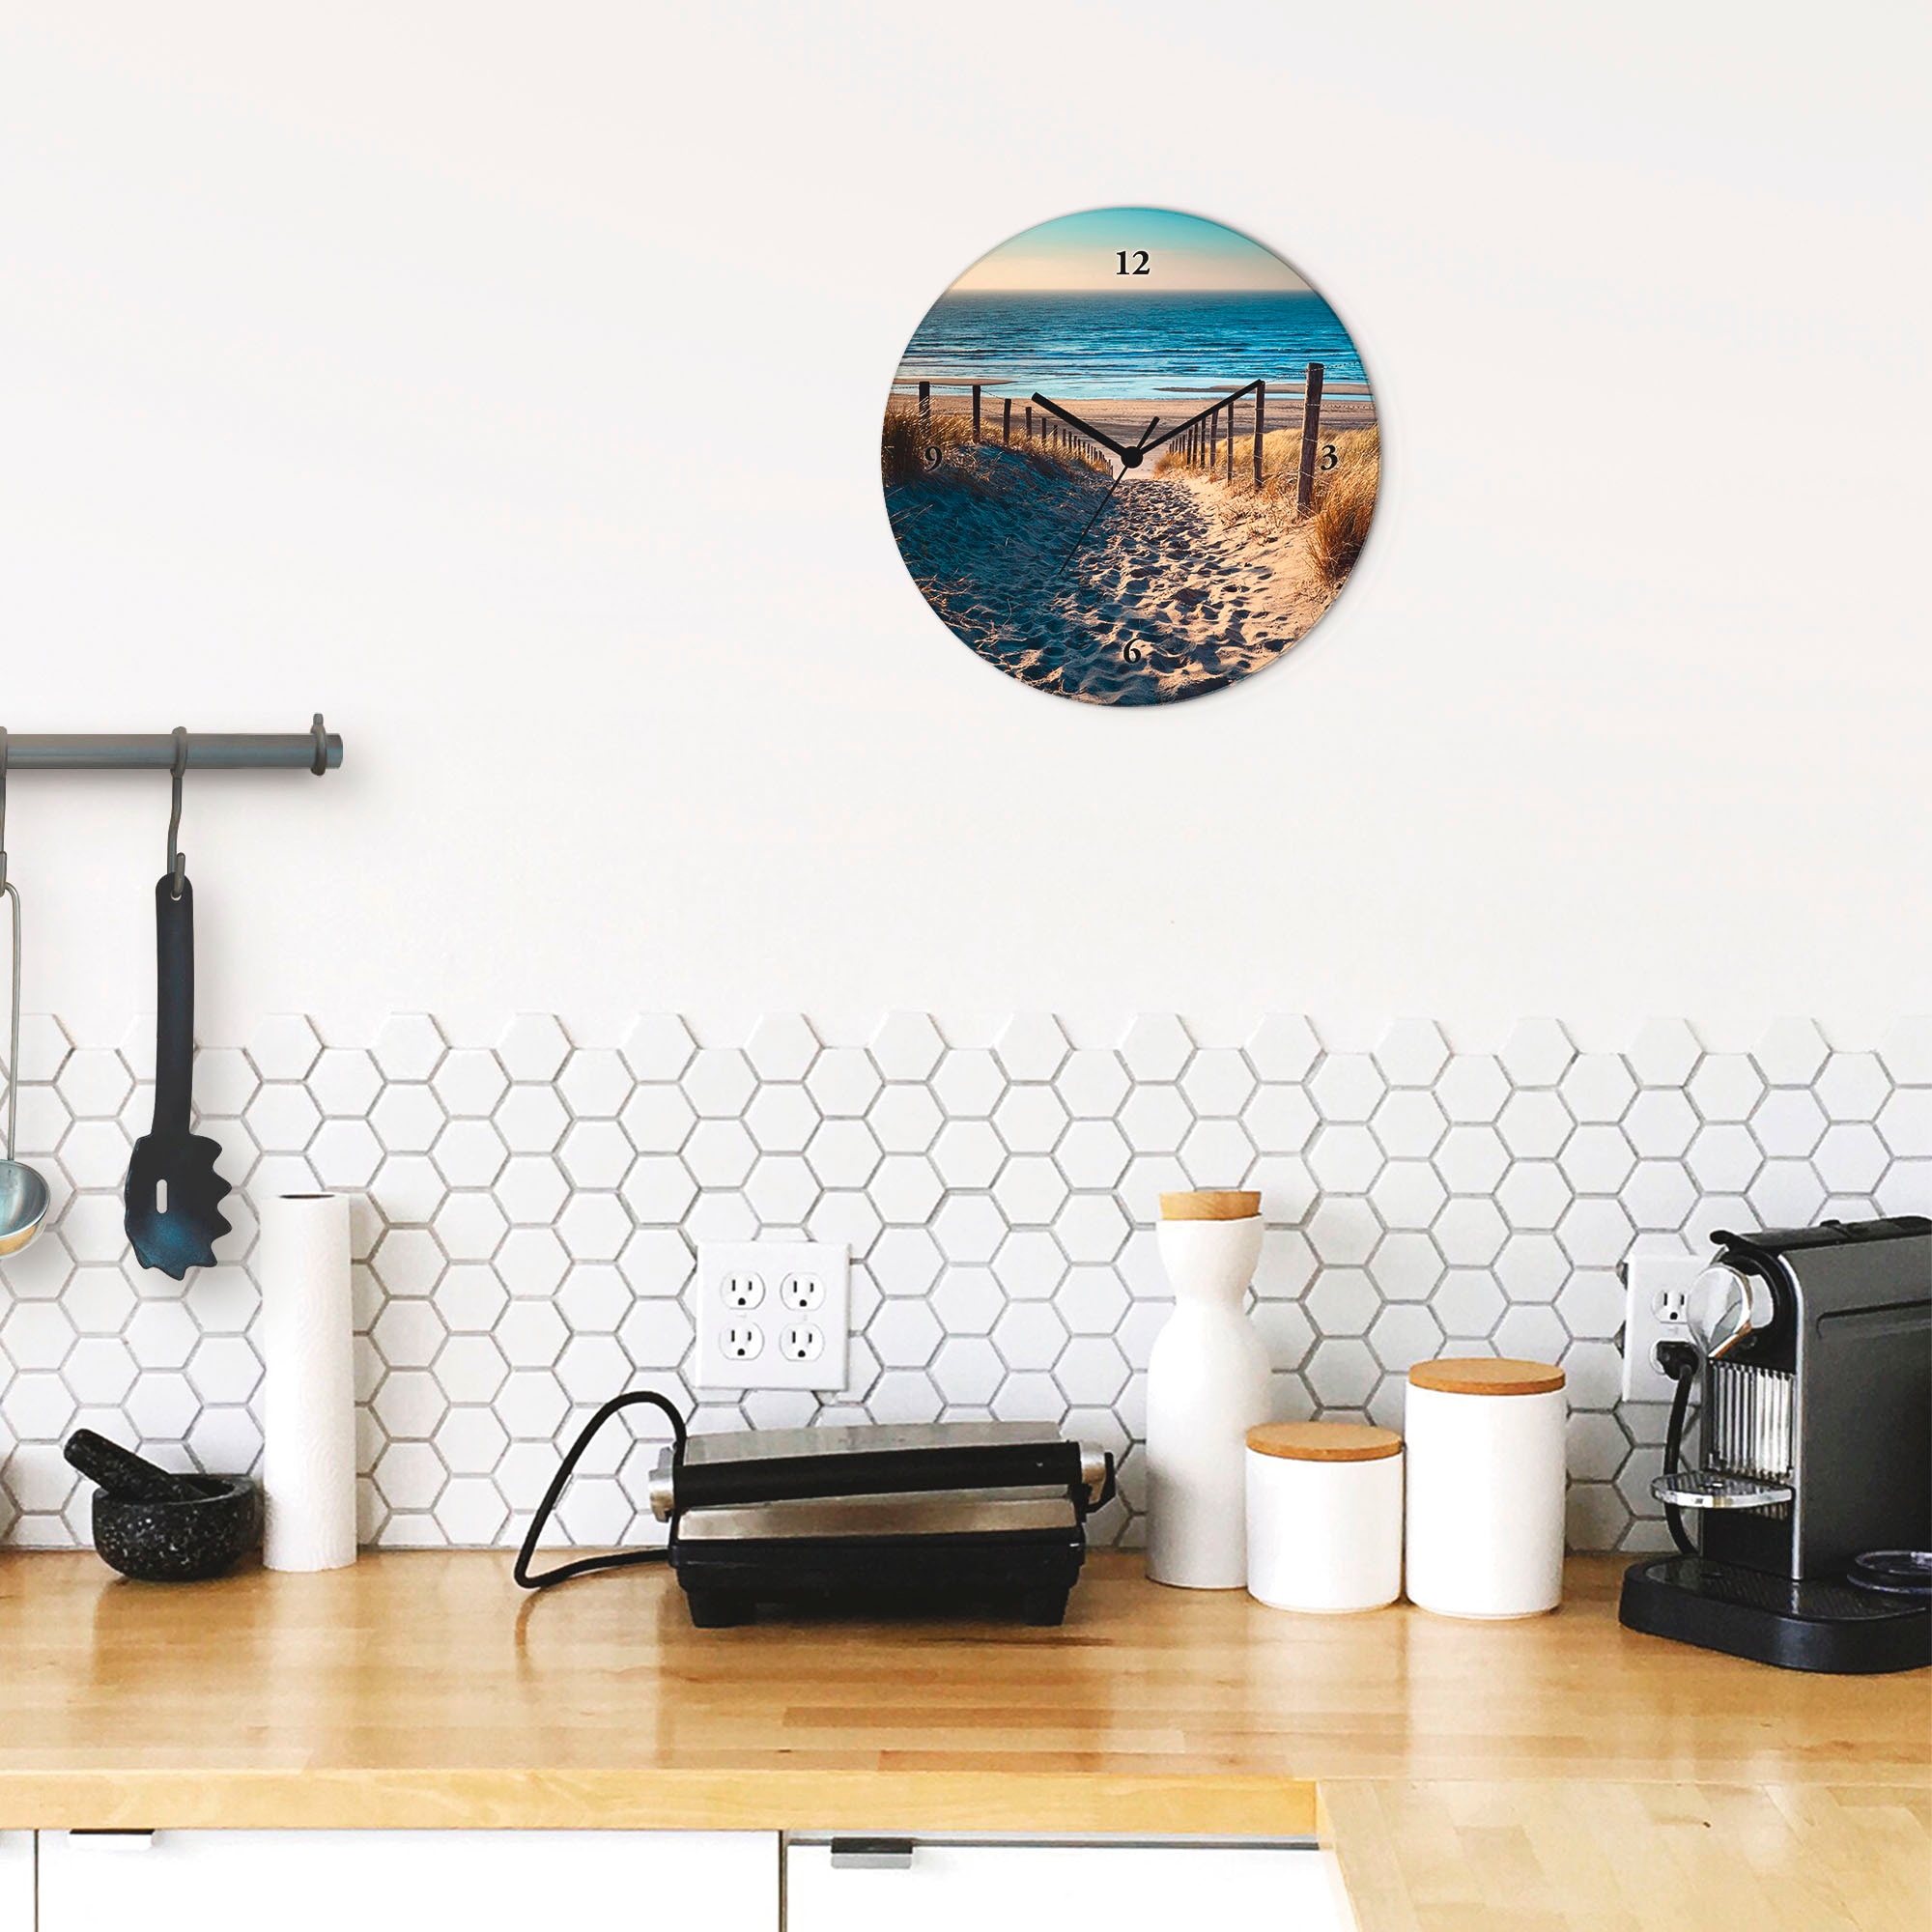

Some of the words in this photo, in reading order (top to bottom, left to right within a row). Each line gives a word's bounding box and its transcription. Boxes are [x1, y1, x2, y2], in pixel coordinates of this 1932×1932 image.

[1116, 250, 1151, 275] 12
[924, 445, 943, 472] 9
[1321, 444, 1338, 470] 3
[1123, 638, 1142, 664] 6
